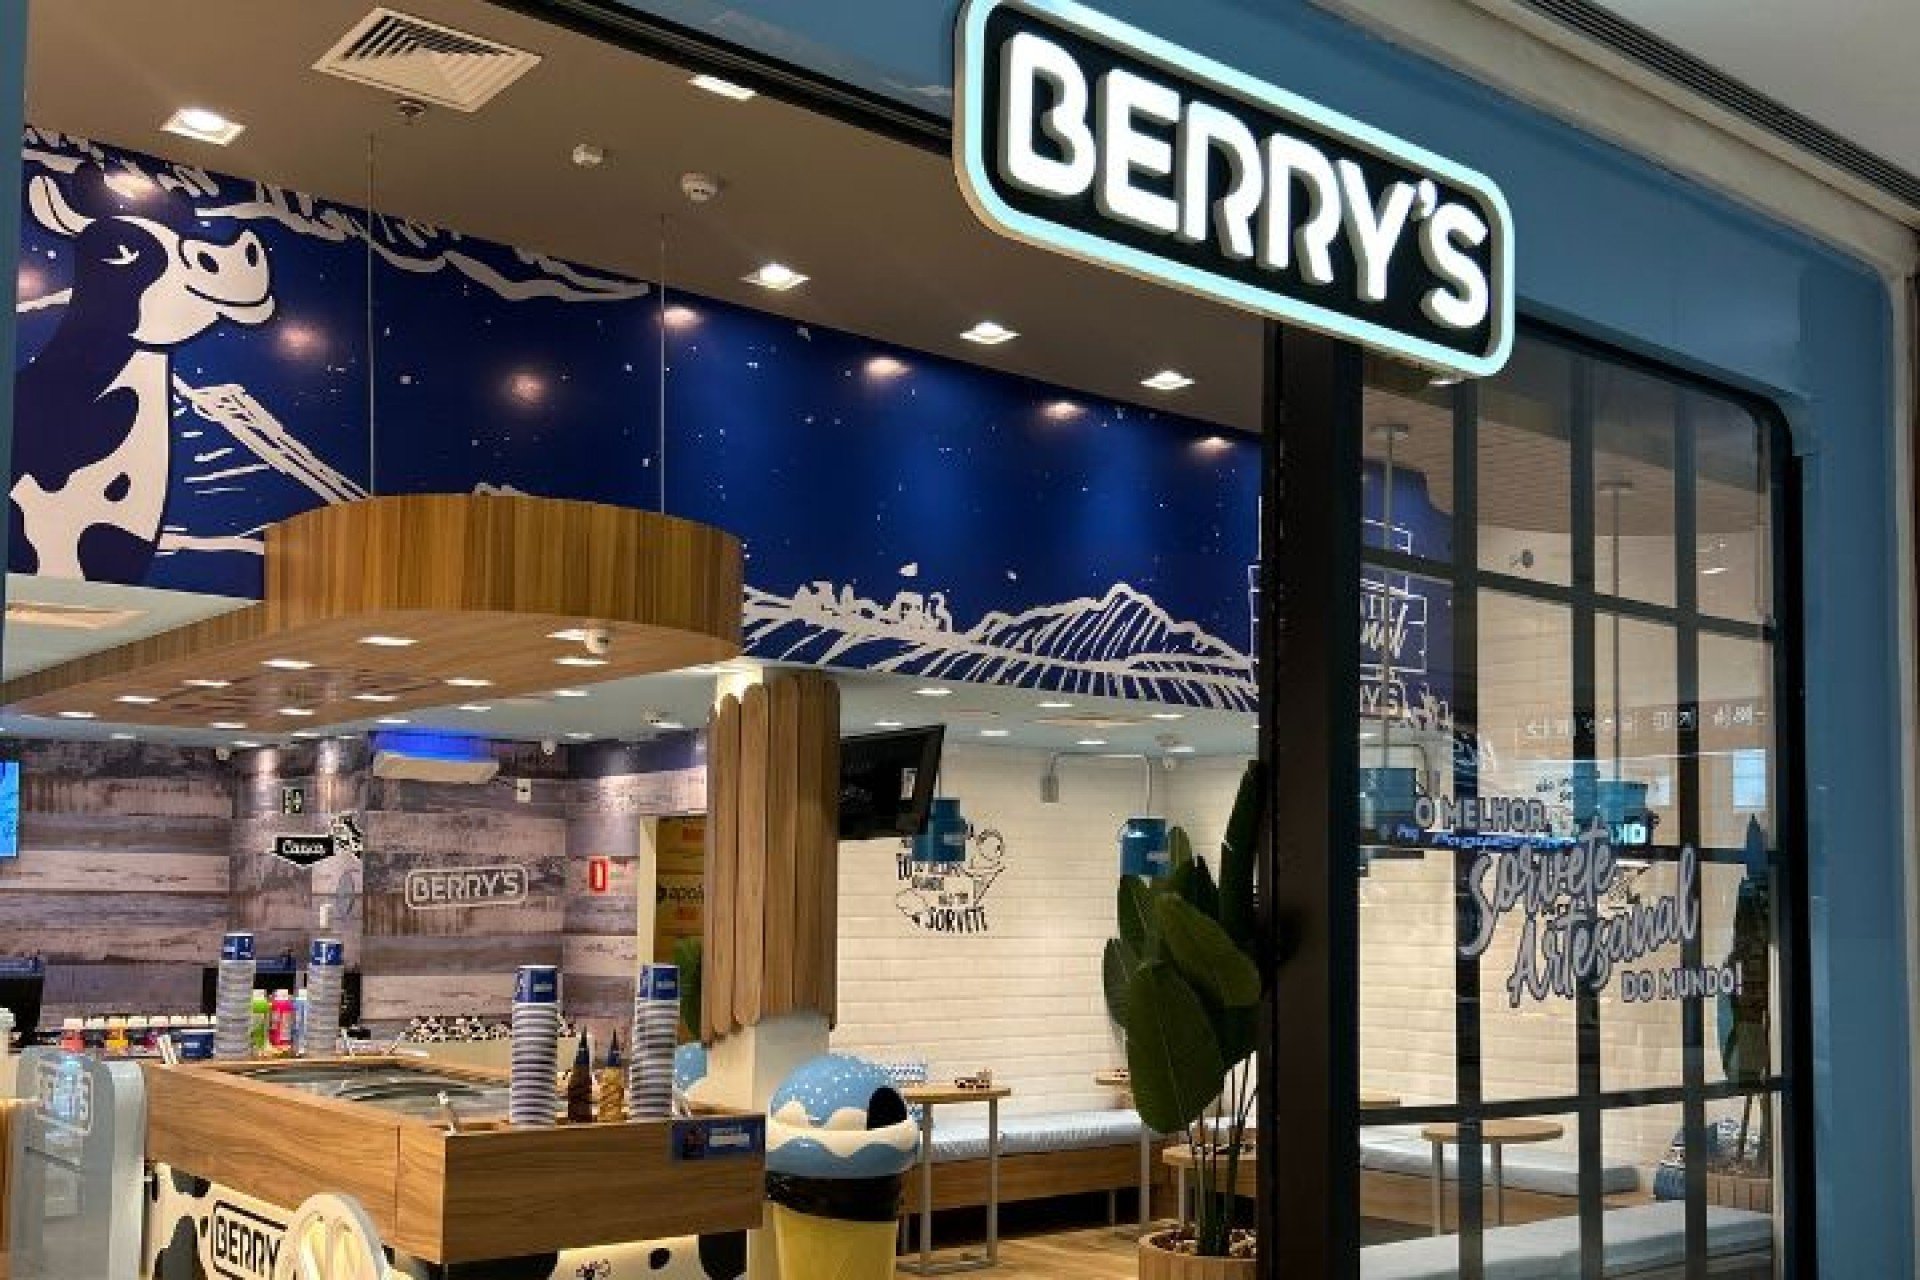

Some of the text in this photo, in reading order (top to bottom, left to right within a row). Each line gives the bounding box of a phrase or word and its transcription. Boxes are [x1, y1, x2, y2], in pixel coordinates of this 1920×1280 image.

[1000, 31, 1489, 328] BERRY'S
[1415, 795, 1548, 832] O MELHOR
[412, 871, 519, 901] BERRY'S
[1456, 816, 1615, 956] Sorvete
[1621, 961, 1742, 1003] DO MUNDO!
